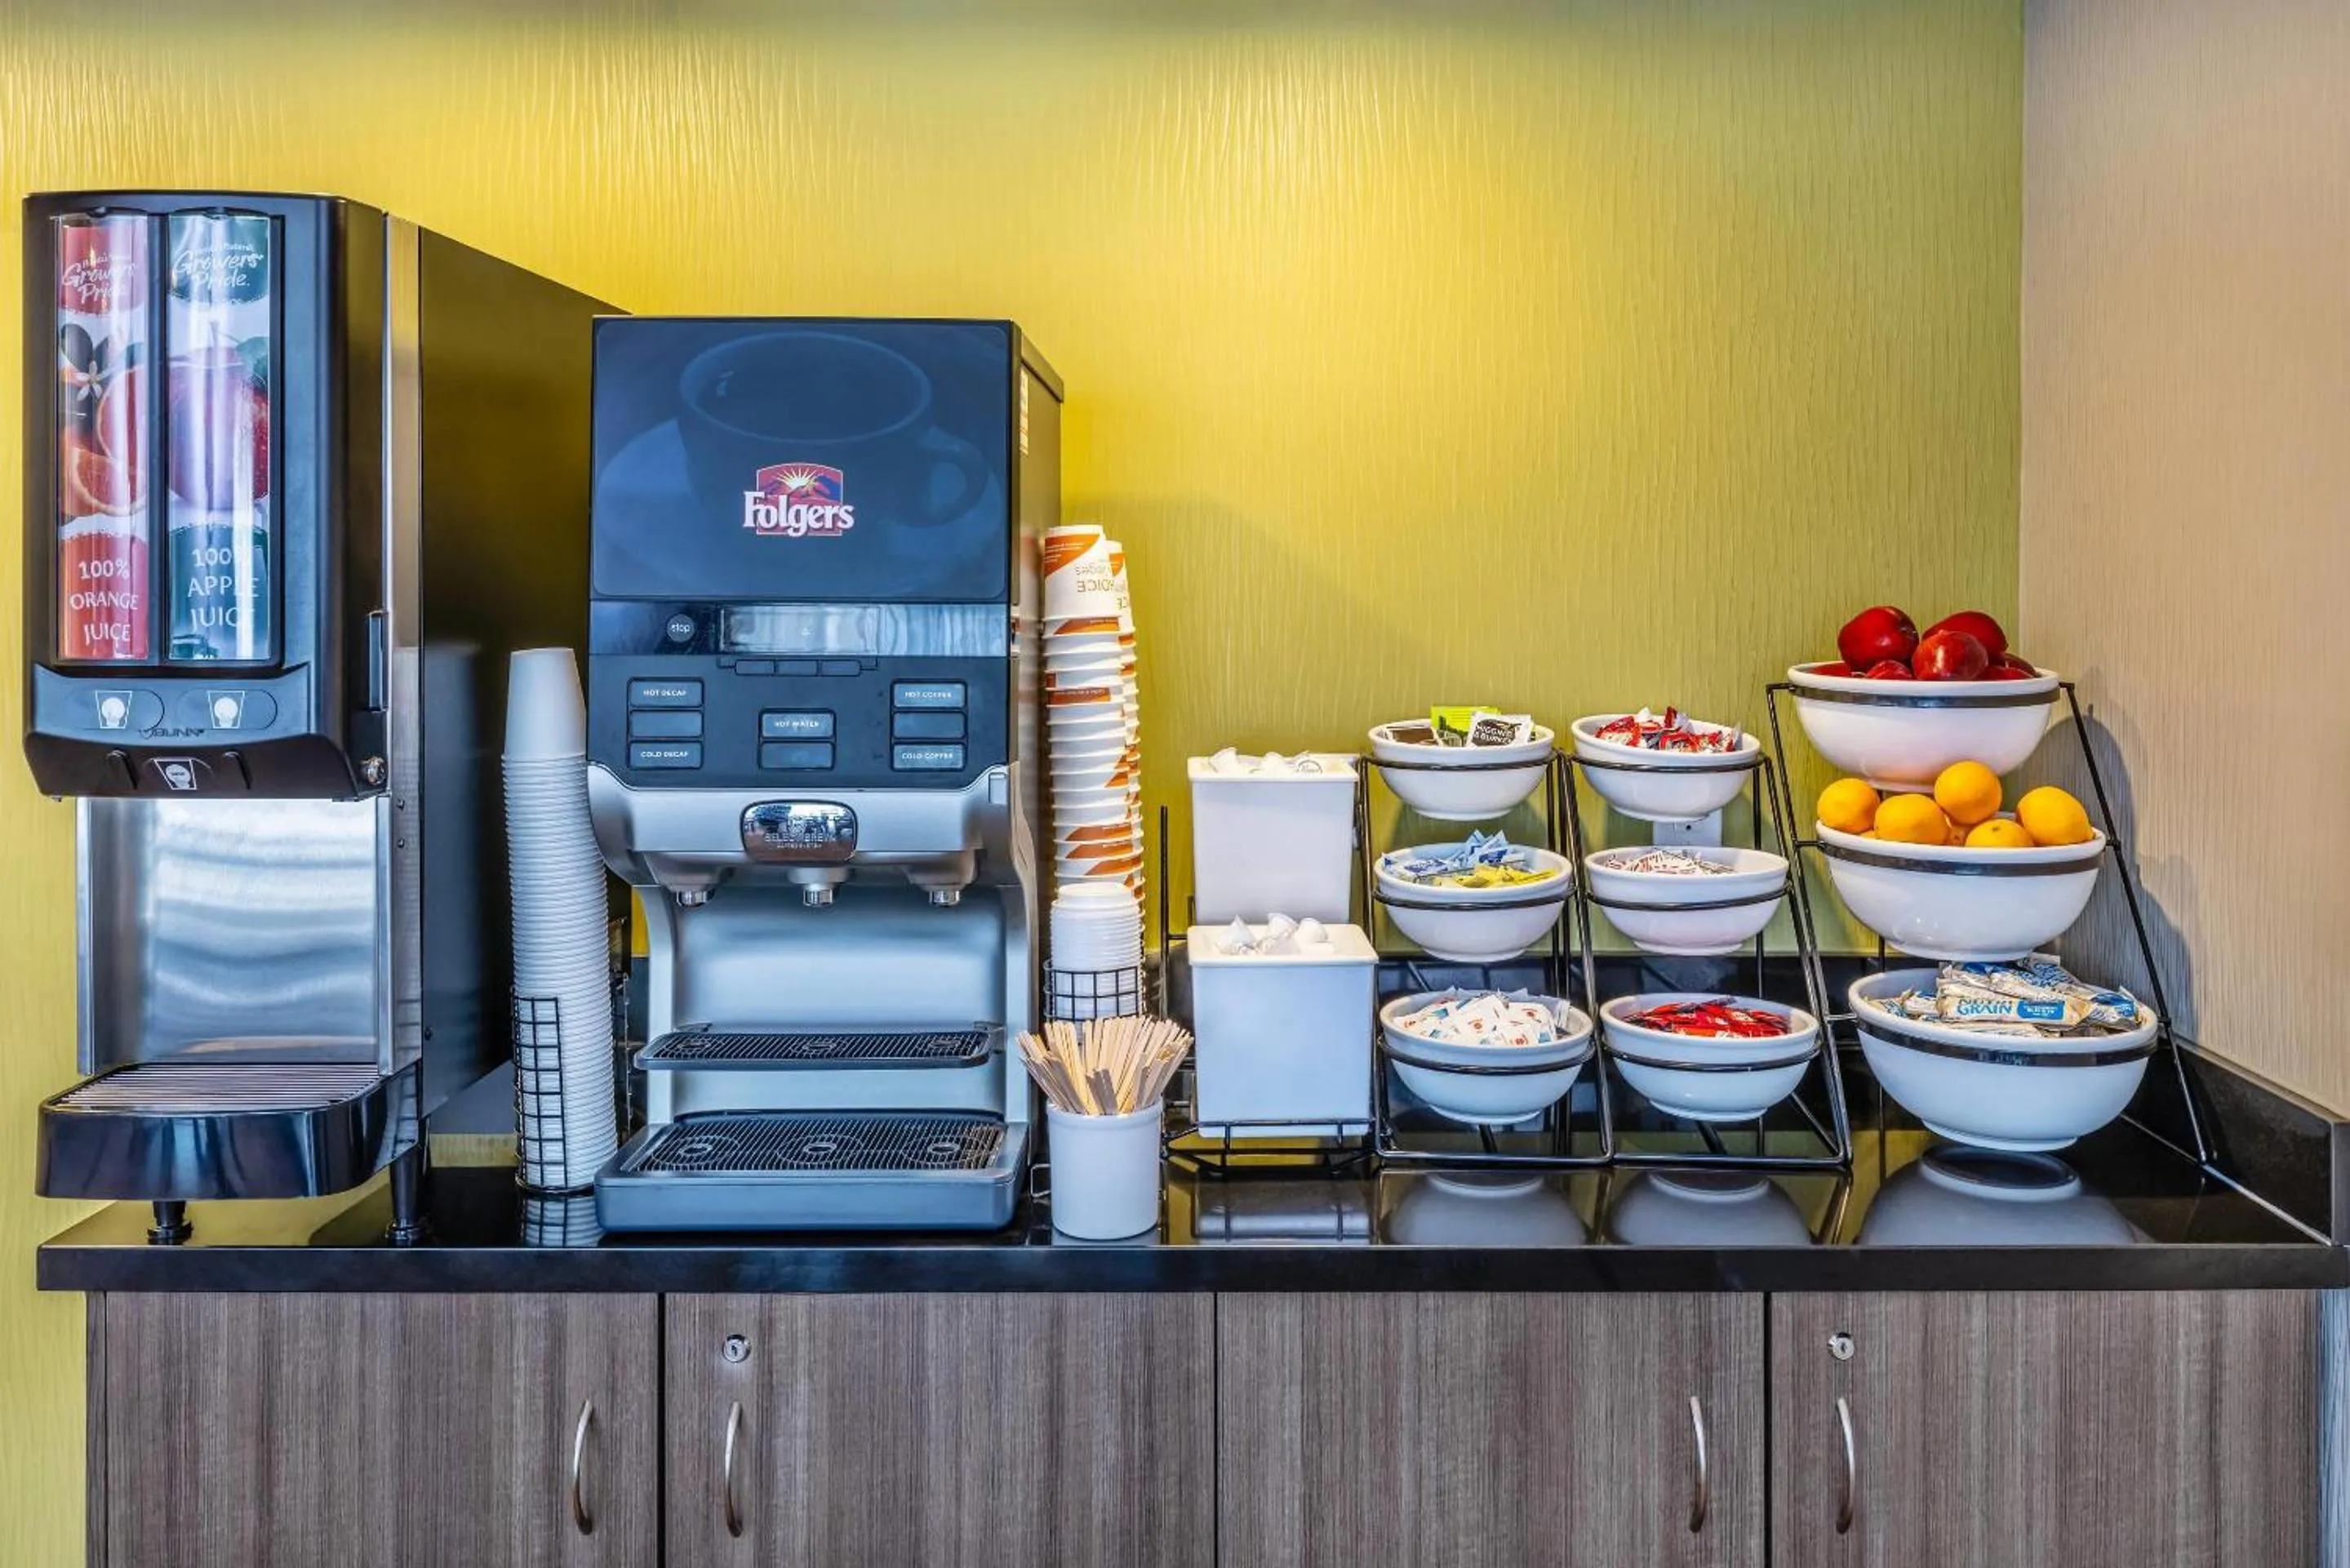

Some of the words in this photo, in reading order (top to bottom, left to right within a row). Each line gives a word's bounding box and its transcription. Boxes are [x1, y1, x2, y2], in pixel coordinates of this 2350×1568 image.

[743, 491, 855, 537] Folgers
[192, 547, 241, 567] 100
[78, 560, 131, 580] 100%
[70, 591, 139, 611] ORANGE
[189, 606, 255, 633] JUIC
[671, 623, 690, 634] stop
[83, 623, 131, 646] JUICE
[792, 721, 820, 729] WATER
[1957, 1004, 2012, 1015] GRAIN
